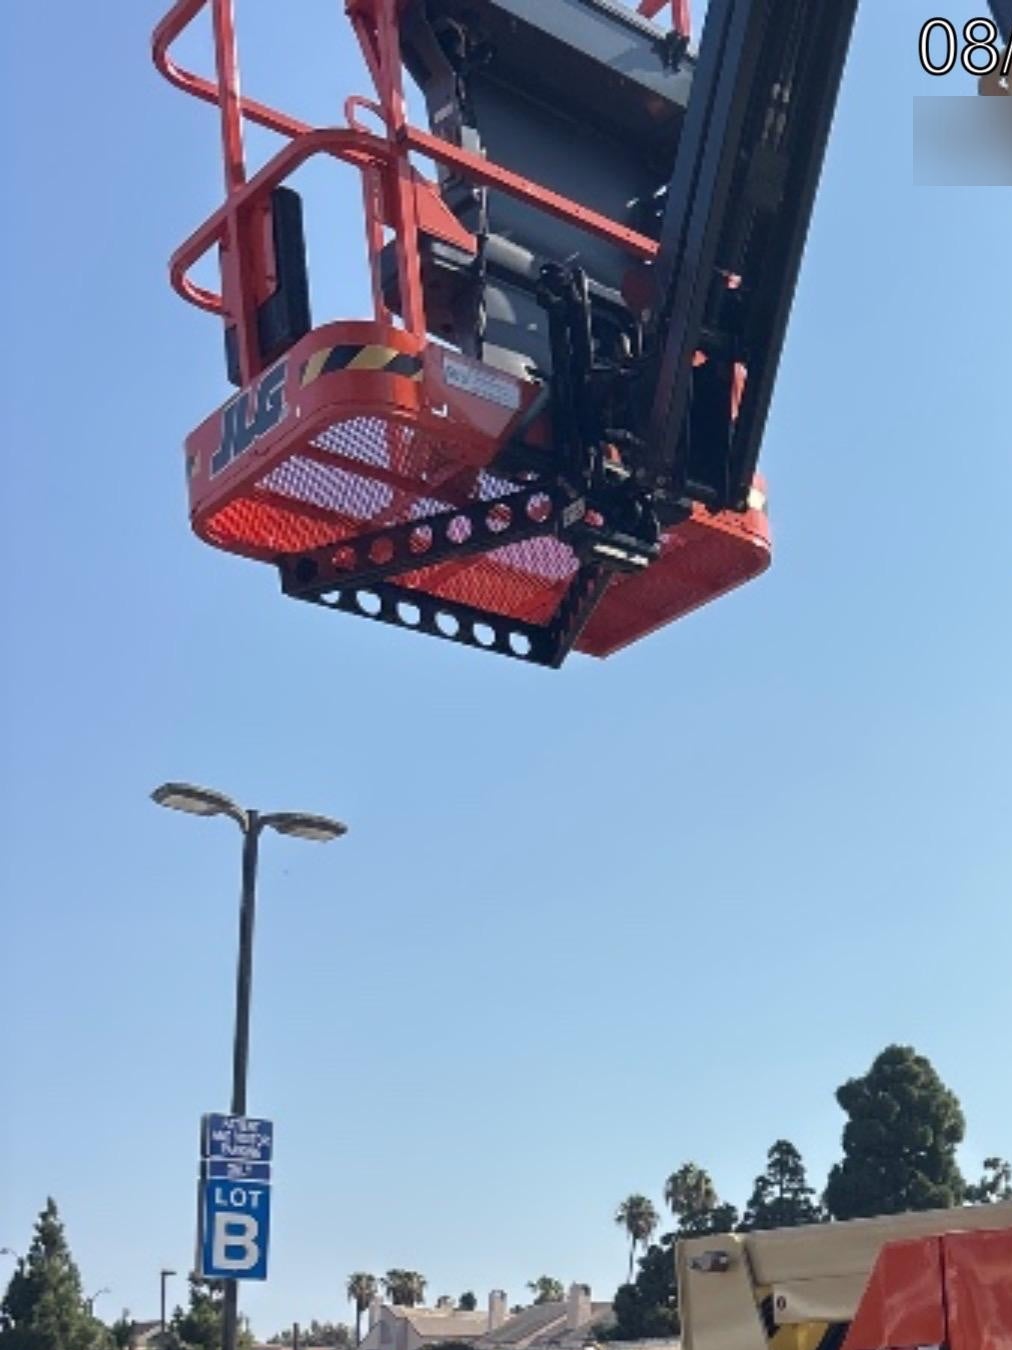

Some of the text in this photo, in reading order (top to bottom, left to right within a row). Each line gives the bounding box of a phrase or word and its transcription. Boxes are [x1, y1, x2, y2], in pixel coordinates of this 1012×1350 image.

[208, 356, 290, 482] JLG
[213, 1186, 262, 1208] LOT
[211, 1210, 260, 1271] B
